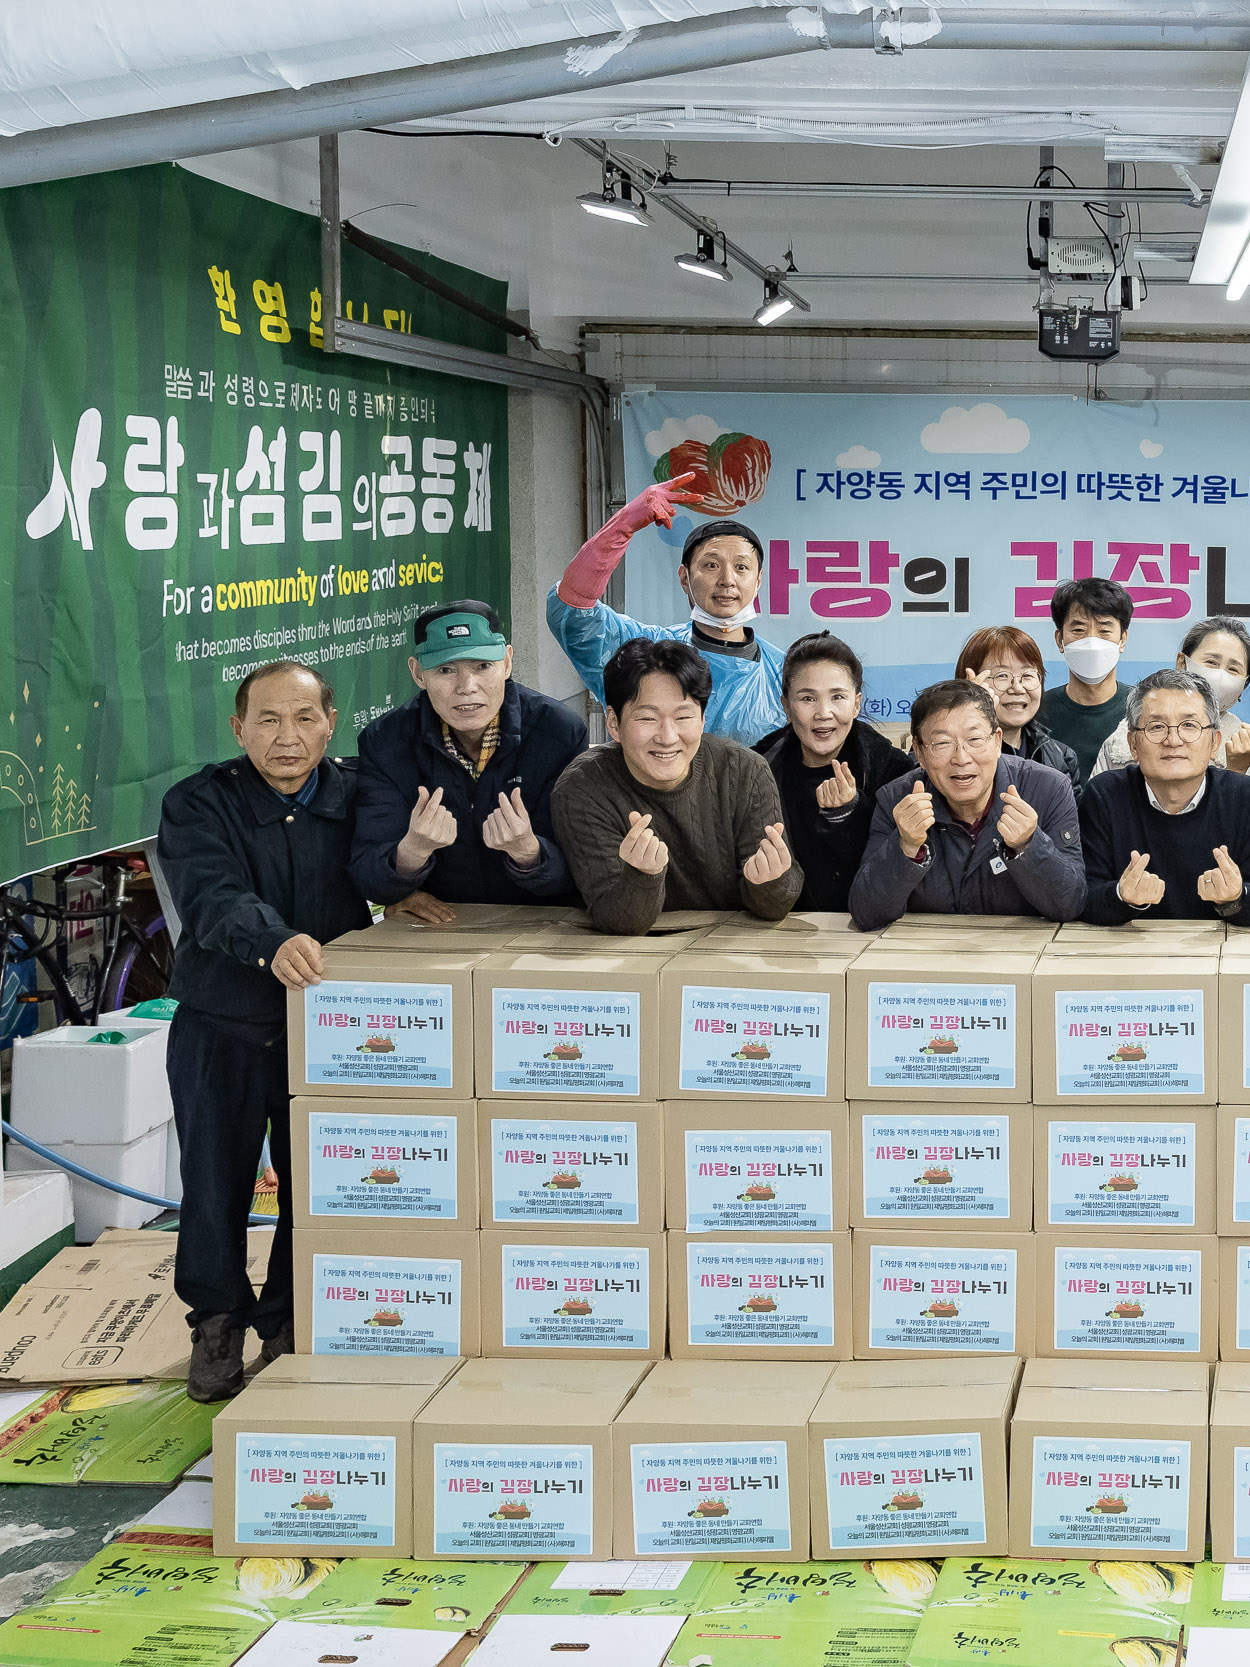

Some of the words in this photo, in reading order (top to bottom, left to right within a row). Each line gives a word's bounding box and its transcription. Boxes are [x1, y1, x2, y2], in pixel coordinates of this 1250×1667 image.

[165, 364, 215, 402] 말씀과
[224, 374, 285, 408] 성령으로
[26, 407, 235, 550] 사랑과
[236, 425, 377, 545] 섬김의
[379, 435, 492, 536] 공동체
[815, 470, 904, 500] 자양동
[913, 471, 971, 500] 지역
[980, 471, 1068, 501] 주민의
[1076, 472, 1164, 503] 따뜻한
[162, 579, 196, 617] For
[200, 585, 213, 614] a
[216, 567, 318, 611] community
[320, 564, 335, 598] of
[338, 564, 369, 595] love
[371, 559, 396, 591] and
[201, 634, 252, 657] becomes
[253, 627, 297, 651] disciples
[297, 623, 317, 642] thru
[318, 621, 331, 637] the
[333, 615, 355, 636] Word
[373, 611, 386, 628] the
[320, 647, 329, 662] to
[329, 643, 344, 660] the
[376, 632, 389, 650] the
[863, 698, 892, 717] (화)
[318, 1012, 360, 1027] 사랑의
[366, 1014, 442, 1030] 김장나누기
[505, 1020, 547, 1035] 사랑의
[554, 1021, 630, 1037] 김장나누기
[881, 1014, 923, 1029] 사랑의
[930, 1015, 1006, 1030] 김장나누기
[1068, 1023, 1111, 1037] 사랑의
[1117, 1022, 1194, 1036] 김장나누기
[322, 1144, 364, 1159] 사랑의
[371, 1146, 447, 1161] 김장나누기
[504, 1150, 546, 1164] 사랑의
[552, 1151, 628, 1166] 김장나누기
[875, 1146, 917, 1159] 사랑의
[924, 1146, 999, 1160] 김장나누기
[1061, 1152, 1103, 1166] 사랑의
[1109, 1153, 1186, 1167] 김장나누기
[515, 1277, 557, 1291] 사랑의
[564, 1278, 639, 1292] 김장나누기
[882, 1278, 924, 1292] 사랑의
[931, 1279, 1007, 1294] 김장나누기
[1067, 1279, 1109, 1293] 사랑의
[1116, 1280, 1191, 1295] 김장나누기
[326, 1286, 368, 1301] 사랑의
[375, 1288, 451, 1305] 김장나누기
[88, 1350, 109, 1366] eats
[250, 1468, 296, 1483] 사랑의
[303, 1469, 385, 1486] 김장나누기
[839, 1470, 885, 1486] 사랑의
[891, 1466, 973, 1484] 김장나누기
[1046, 1471, 1091, 1487] 사랑의
[1098, 1472, 1179, 1489] 김장나누기
[448, 1478, 493, 1493] 사랑의
[500, 1479, 582, 1494] 김장나누기
